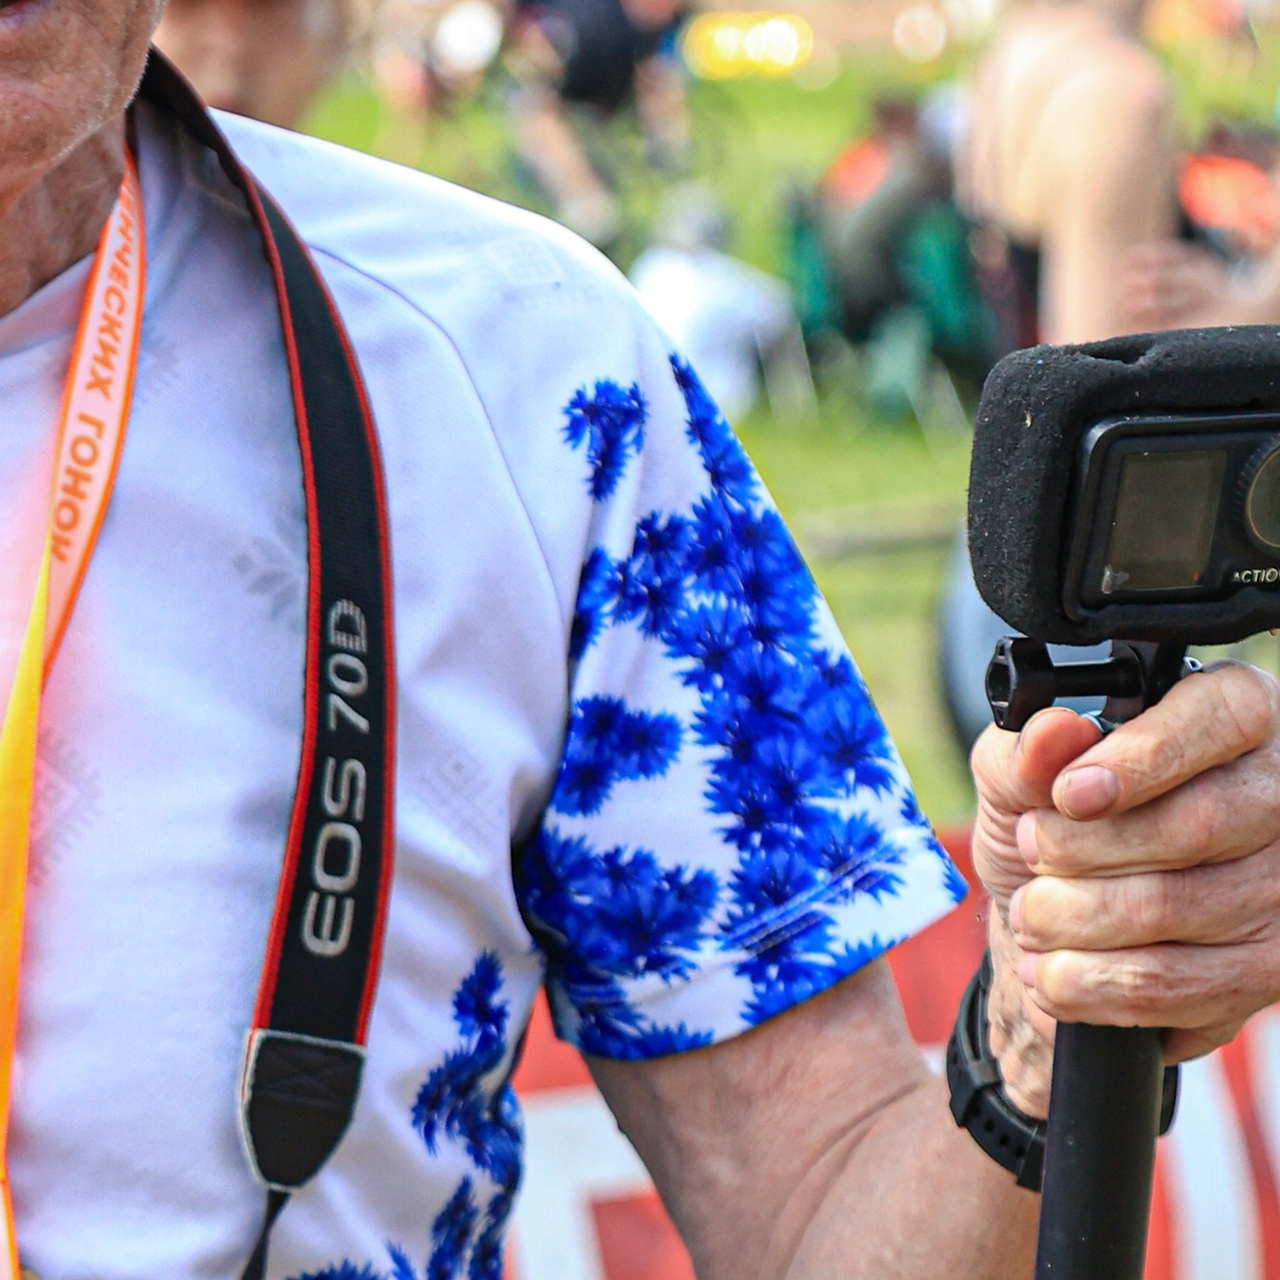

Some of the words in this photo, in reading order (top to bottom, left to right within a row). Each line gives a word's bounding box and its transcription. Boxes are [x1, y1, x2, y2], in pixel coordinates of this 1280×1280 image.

[1232, 567, 1280, 583] ACTIO
[327, 599, 371, 735] 70D
[304, 756, 369, 958] EOS
